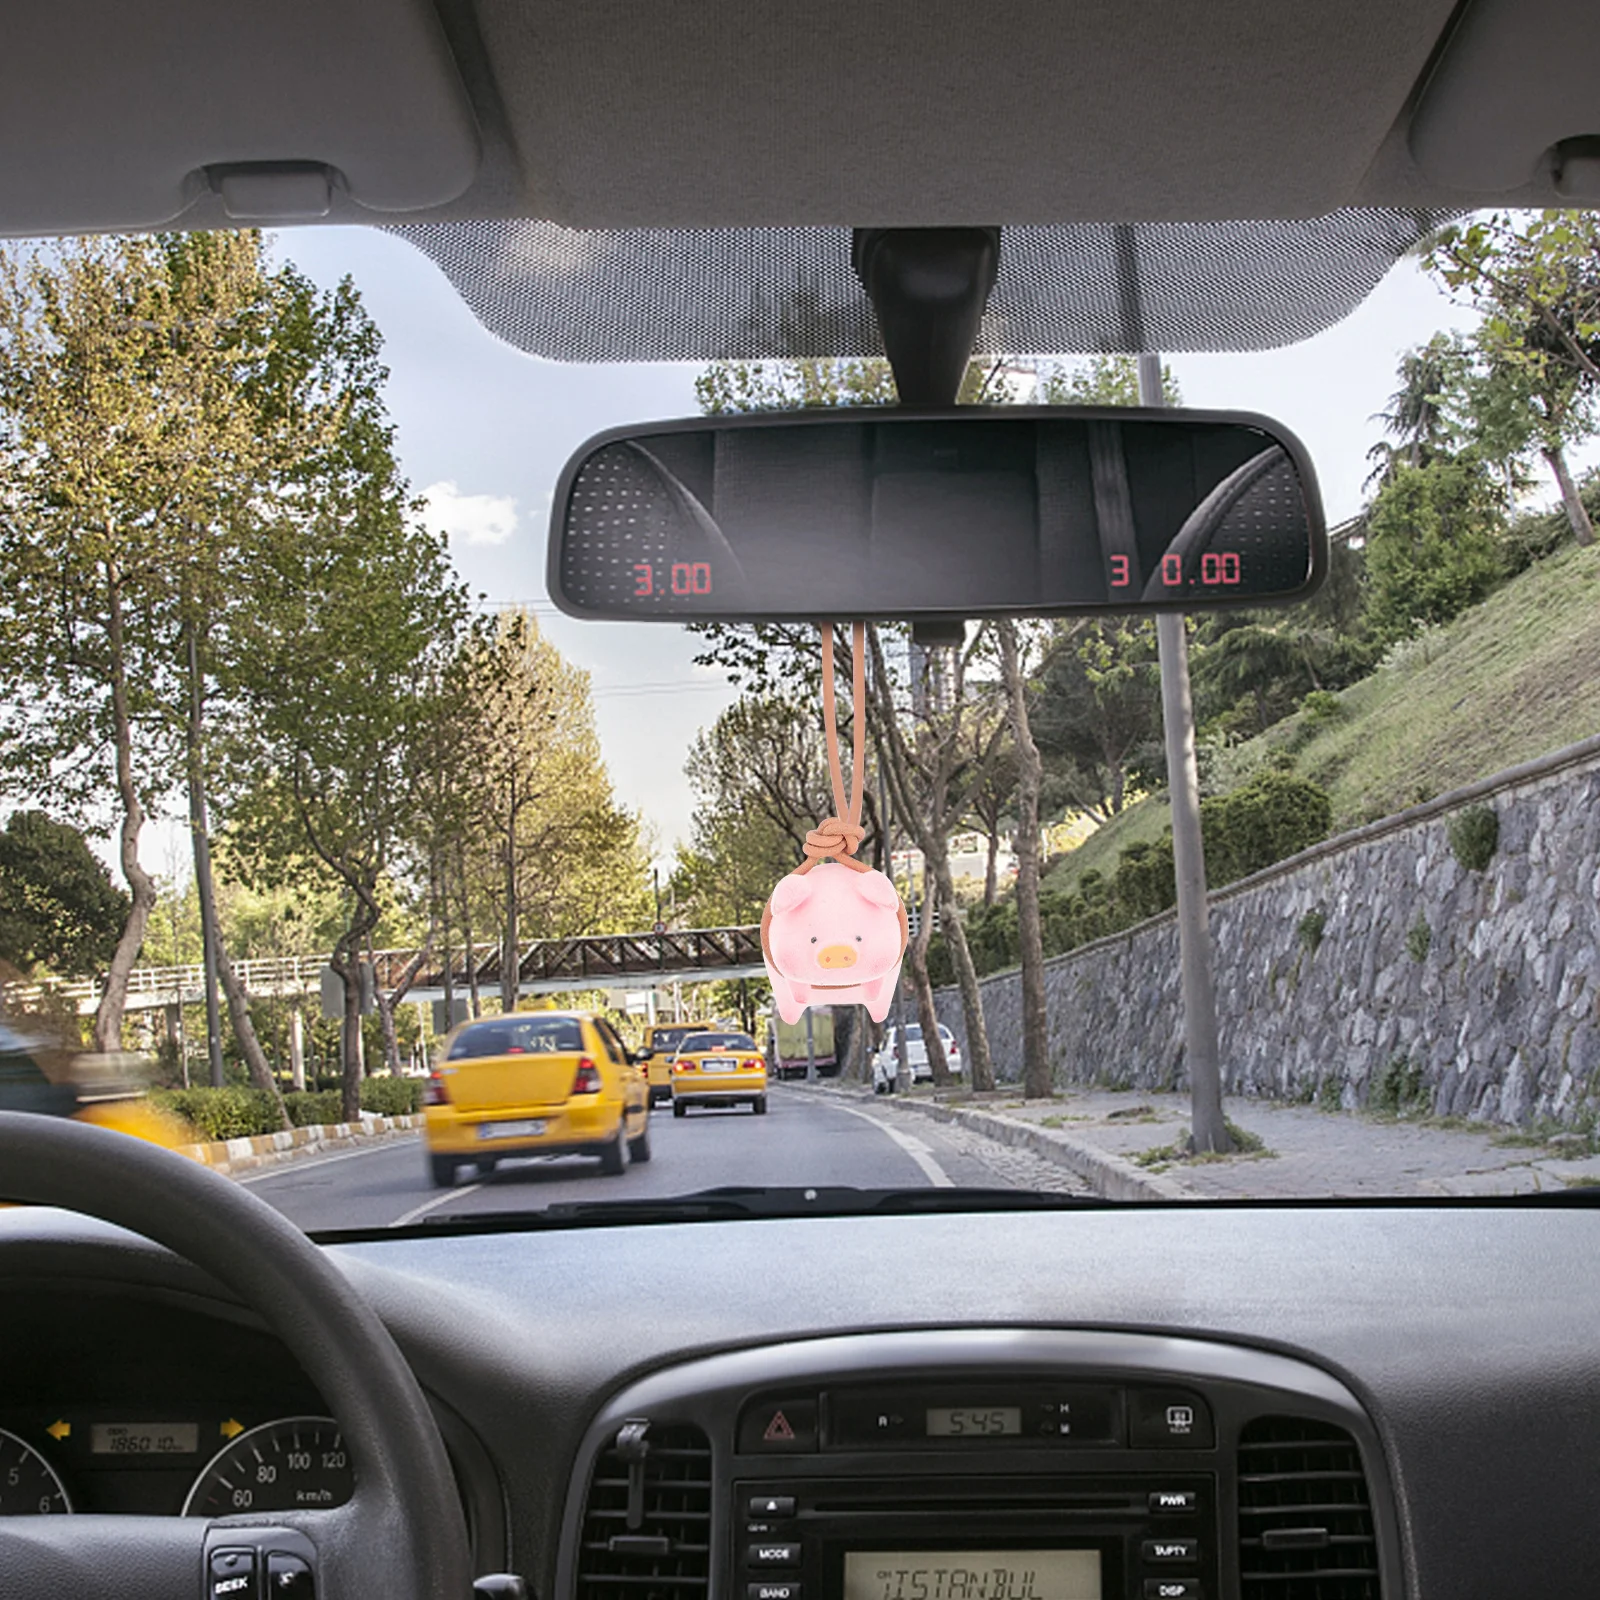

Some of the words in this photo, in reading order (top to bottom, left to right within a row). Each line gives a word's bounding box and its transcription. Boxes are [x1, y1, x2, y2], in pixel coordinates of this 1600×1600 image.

[1110, 554, 1129, 586] 3
[1161, 552, 1240, 586] 0.00
[633, 563, 711, 596] 3.00
[950, 1411, 1005, 1434] 5:45
[287, 1452, 311, 1469] 100
[322, 1451, 346, 1468] 120
[8, 1467, 19, 1487] 5
[256, 1466, 277, 1483] 80
[232, 1489, 253, 1507] 60
[296, 1488, 332, 1501] km/h
[1160, 1494, 1186, 1506] PWR
[39, 1496, 50, 1513] 6
[759, 1549, 789, 1559] MODE
[760, 1587, 790, 1598] BAND
